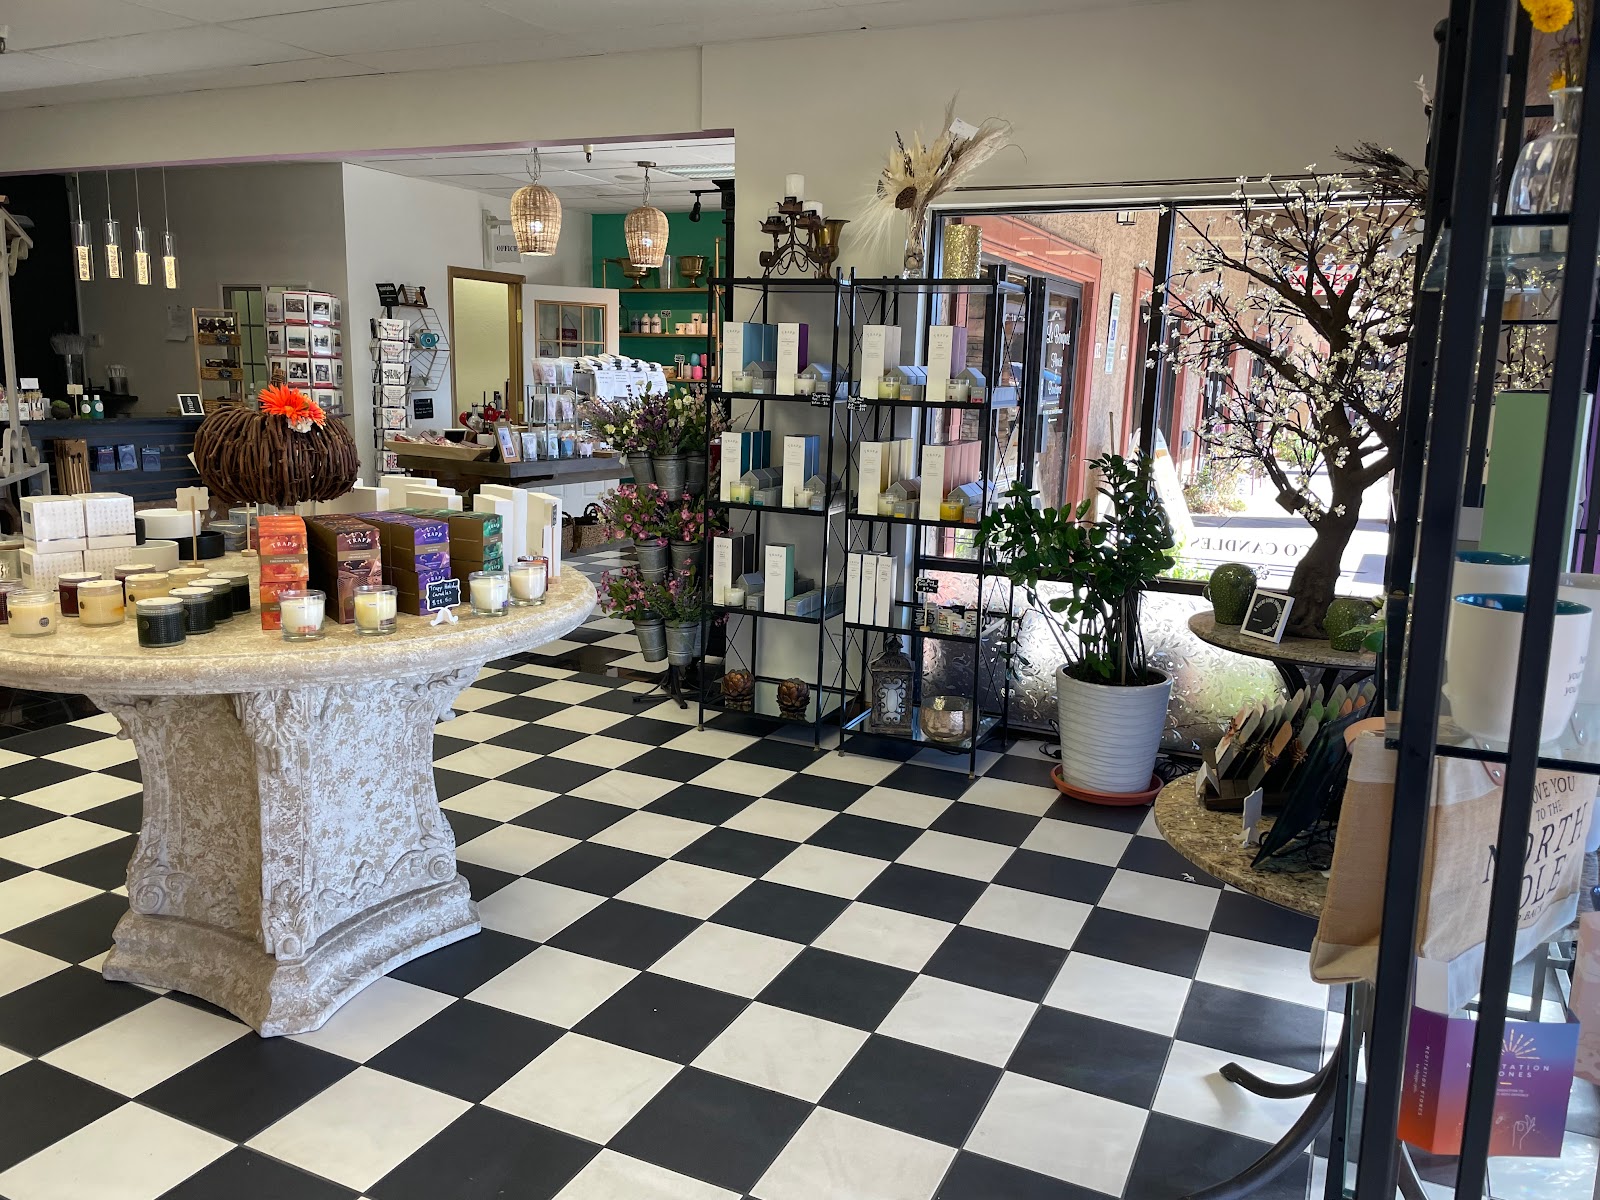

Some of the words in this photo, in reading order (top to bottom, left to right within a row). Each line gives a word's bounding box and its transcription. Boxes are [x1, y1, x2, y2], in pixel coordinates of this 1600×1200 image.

[1288, 274, 1354, 289] BAER
[423, 531, 442, 539] TRAPP
[1533, 782, 1550, 804] OVE
[1550, 776, 1575, 794] YOU
[1535, 808, 1546, 821] TO
[1547, 799, 1563, 816] THE
[1421, 1045, 1431, 1088] MEDITATION
[1466, 1062, 1550, 1072] MTATION
[1498, 1070, 1532, 1078] ONES
[1417, 1090, 1425, 1116] STONES
